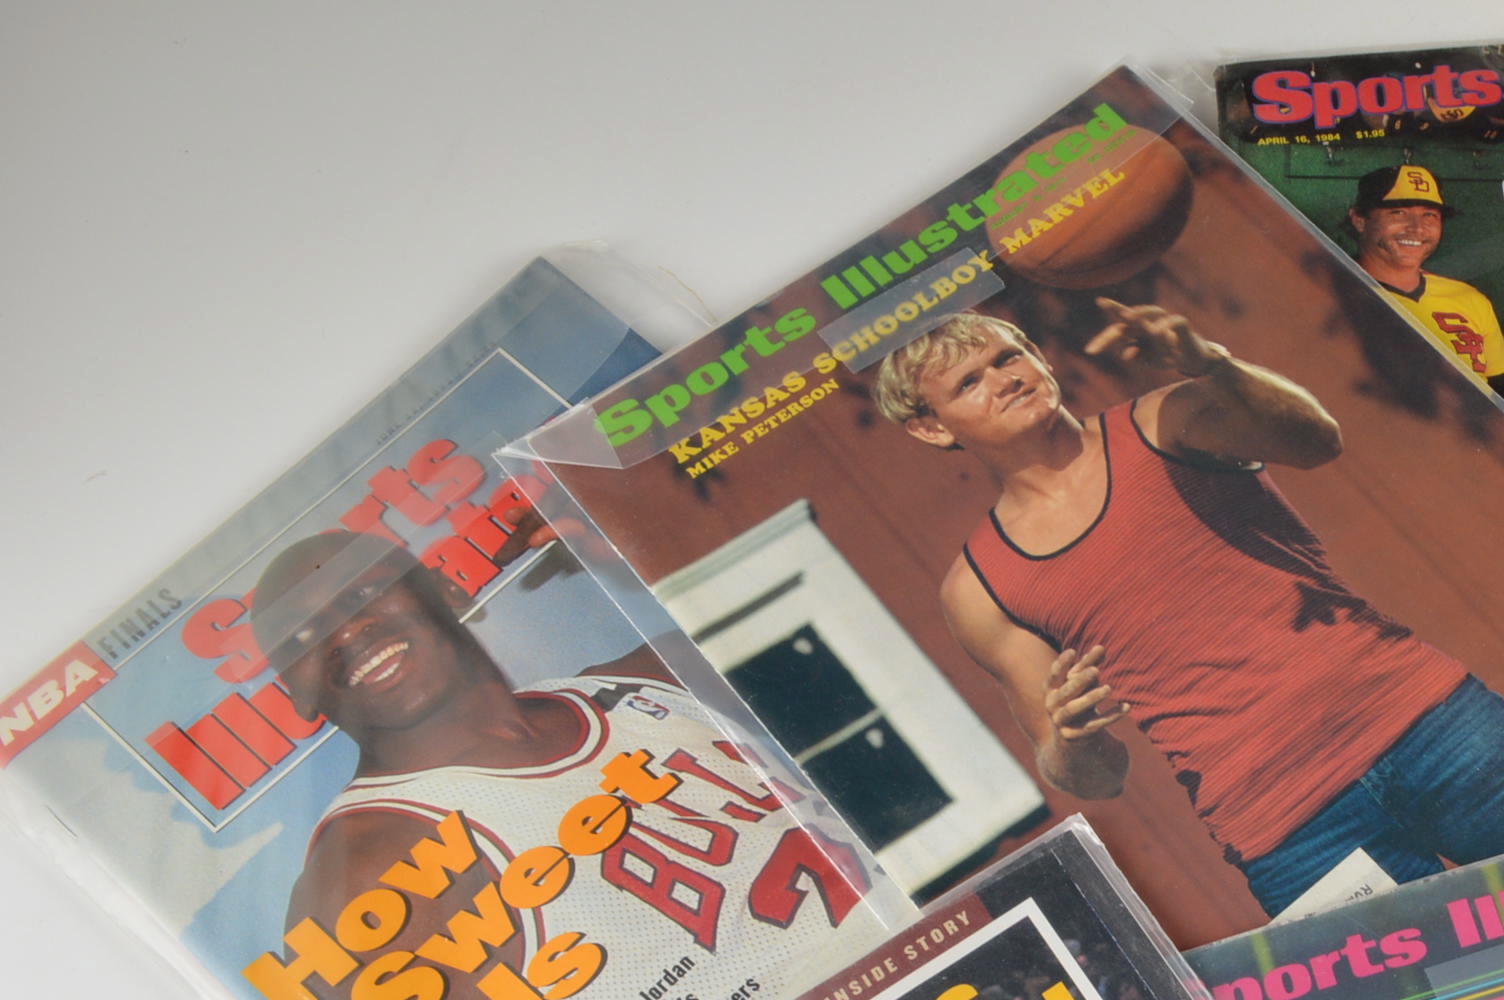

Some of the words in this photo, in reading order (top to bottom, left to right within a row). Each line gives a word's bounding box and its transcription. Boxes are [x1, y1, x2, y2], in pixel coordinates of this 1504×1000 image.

[1252, 65, 1502, 130] Sports
[1257, 137, 1290, 147] APRIL
[1295, 135, 1311, 145] 16,
[1315, 132, 1341, 143] 1984
[1355, 128, 1385, 140] $1.95
[594, 307, 818, 448] Sports
[820, 103, 1128, 309] Illustrated
[668, 371, 807, 464] KANSAS
[812, 250, 996, 376] SCHOOLBOY
[999, 167, 1126, 255] MARVEL
[686, 446, 739, 480] MIKE
[741, 378, 840, 446] PETERSON
[0, 659, 98, 746] NBA
[97, 588, 183, 660] FINALS
[904, 910, 972, 961] STORY
